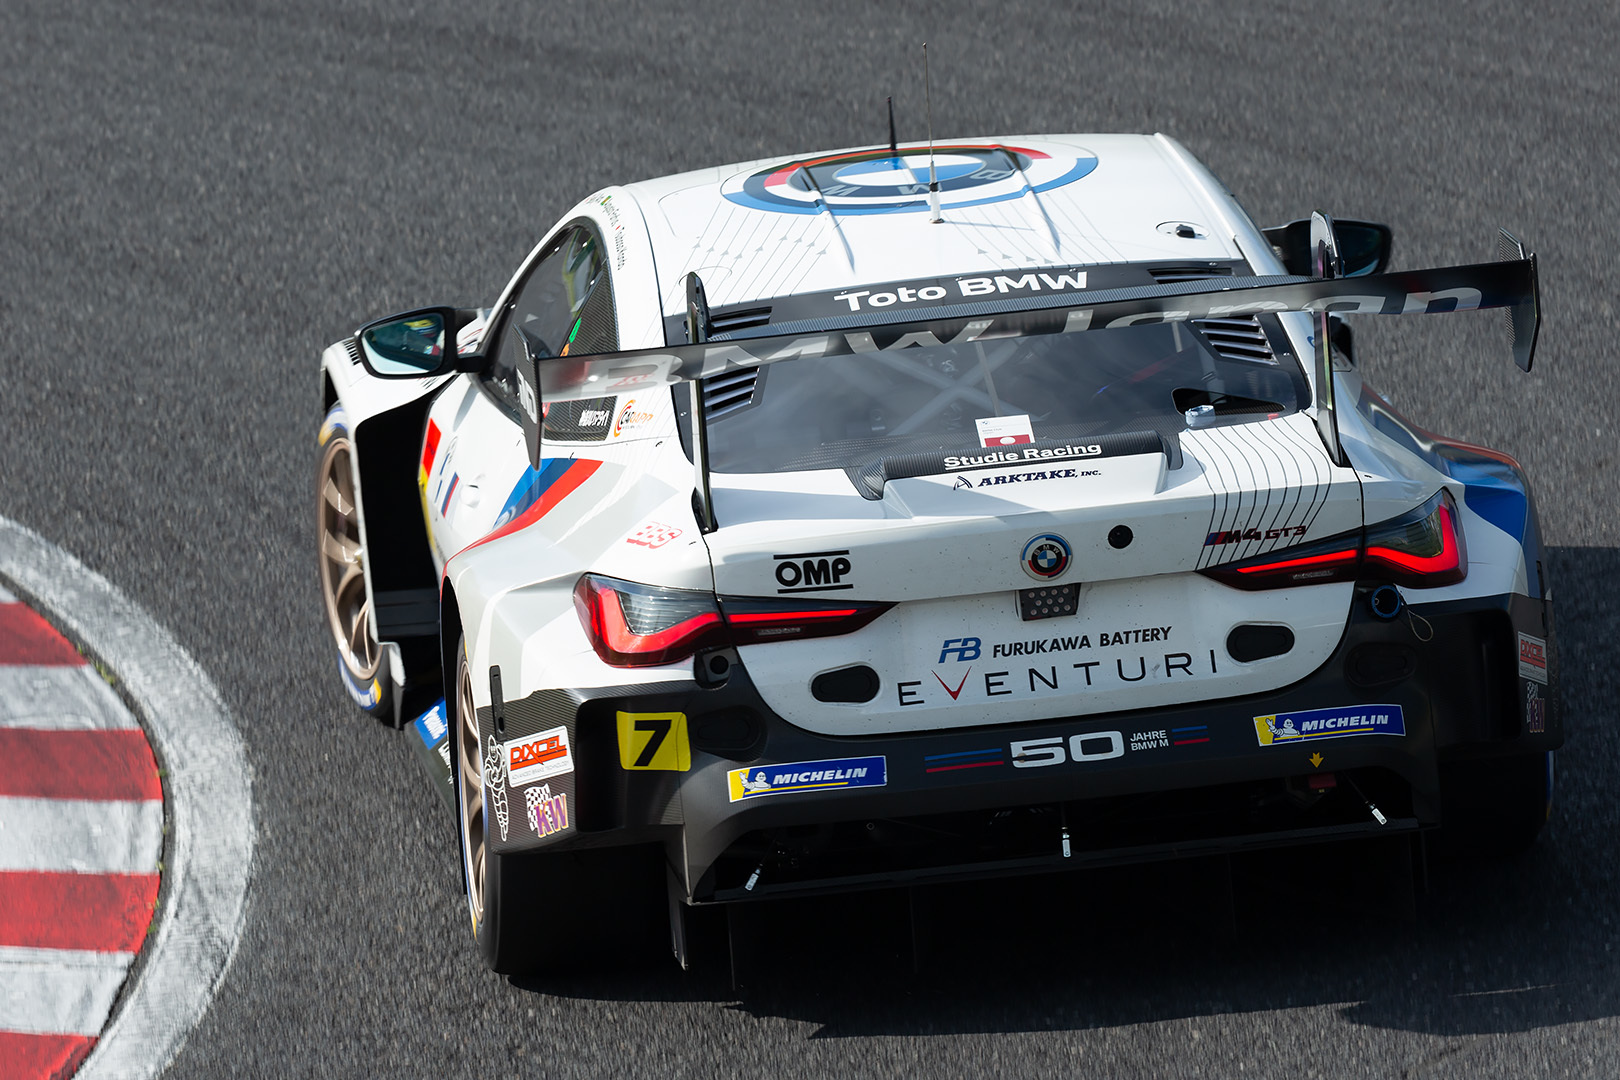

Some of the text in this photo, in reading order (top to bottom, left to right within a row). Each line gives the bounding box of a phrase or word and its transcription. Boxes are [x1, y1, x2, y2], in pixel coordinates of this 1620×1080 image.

[833, 271, 1088, 312] Toto BMW
[943, 444, 1102, 468] Studie Racing
[978, 469, 1078, 487] ARKTAKE,
[626, 520, 683, 549] BBS
[1265, 526, 1306, 540] GT3
[1033, 544, 1060, 556] BMW
[775, 557, 851, 587] OMP
[938, 626, 1172, 663] FB FURUKAWA BATTERY
[897, 649, 1218, 706] EVENTURI
[1130, 730, 1167, 742] JAHRE
[1301, 715, 1389, 732] MICHELIN
[510, 735, 567, 765] DIXCEL
[633, 719, 672, 767] 7
[1010, 730, 1125, 768] 50
[1131, 739, 1169, 751] BMW M
[773, 767, 868, 785] MICHELIN
[534, 793, 569, 838] KW
